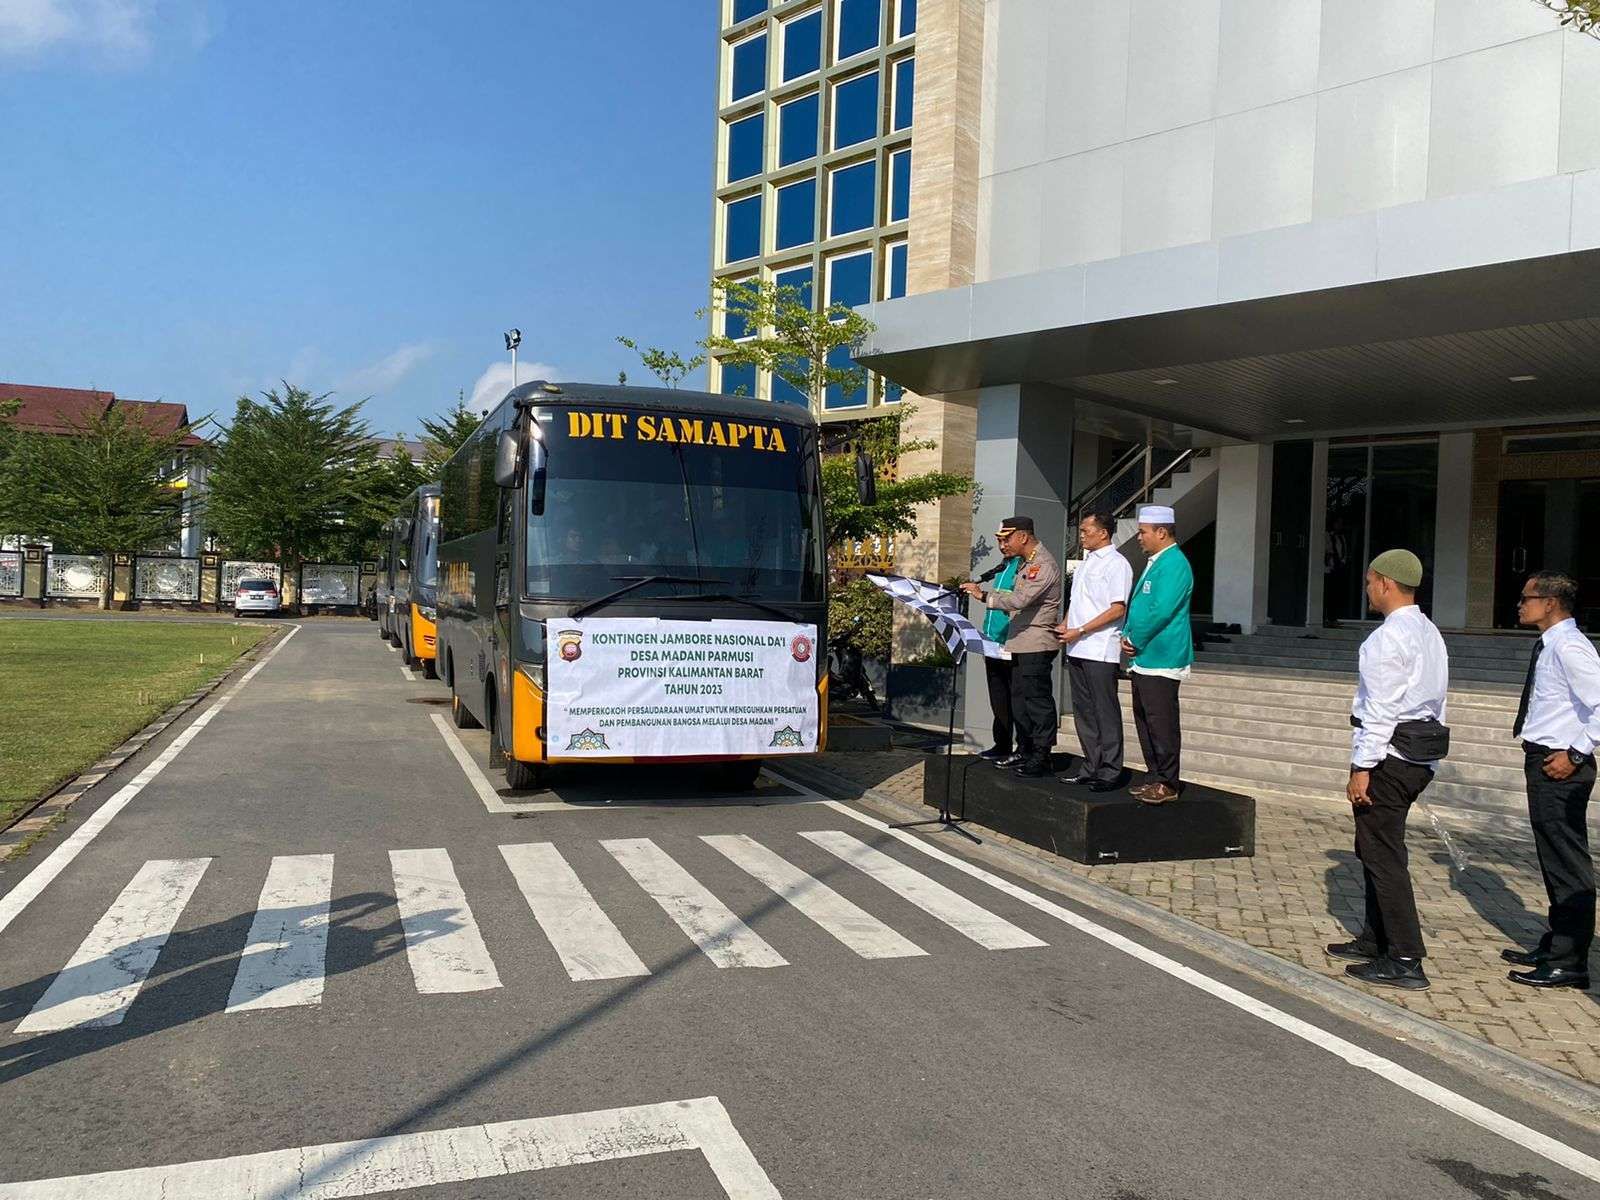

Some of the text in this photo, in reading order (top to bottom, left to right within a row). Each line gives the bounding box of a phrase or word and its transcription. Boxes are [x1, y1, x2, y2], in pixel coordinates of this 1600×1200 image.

[567, 411, 787, 453] DIT SAMAPTA
[592, 633, 786, 647] KONTINGEN JAMBORE NASIONAL DA'I
[630, 650, 754, 662] DESA MADANI PARMUSI
[618, 667, 764, 679] PROVINSI KALIMANTAN BARAT
[664, 683, 723, 695] TAHUN 2023
[627, 705, 684, 715] PERSAUDARAAN
[684, 705, 704, 714] UMAT
[705, 705, 729, 714] UNTUK
[729, 705, 773, 714] MENEGUHKAN
[773, 706, 807, 714] PERSATUAN
[599, 719, 615, 728] DAN
[616, 718, 672, 728] PEMBANGUNAN
[673, 717, 700, 727] BANGSA
[702, 717, 731, 726] MELALUI
[731, 717, 748, 726] DESA
